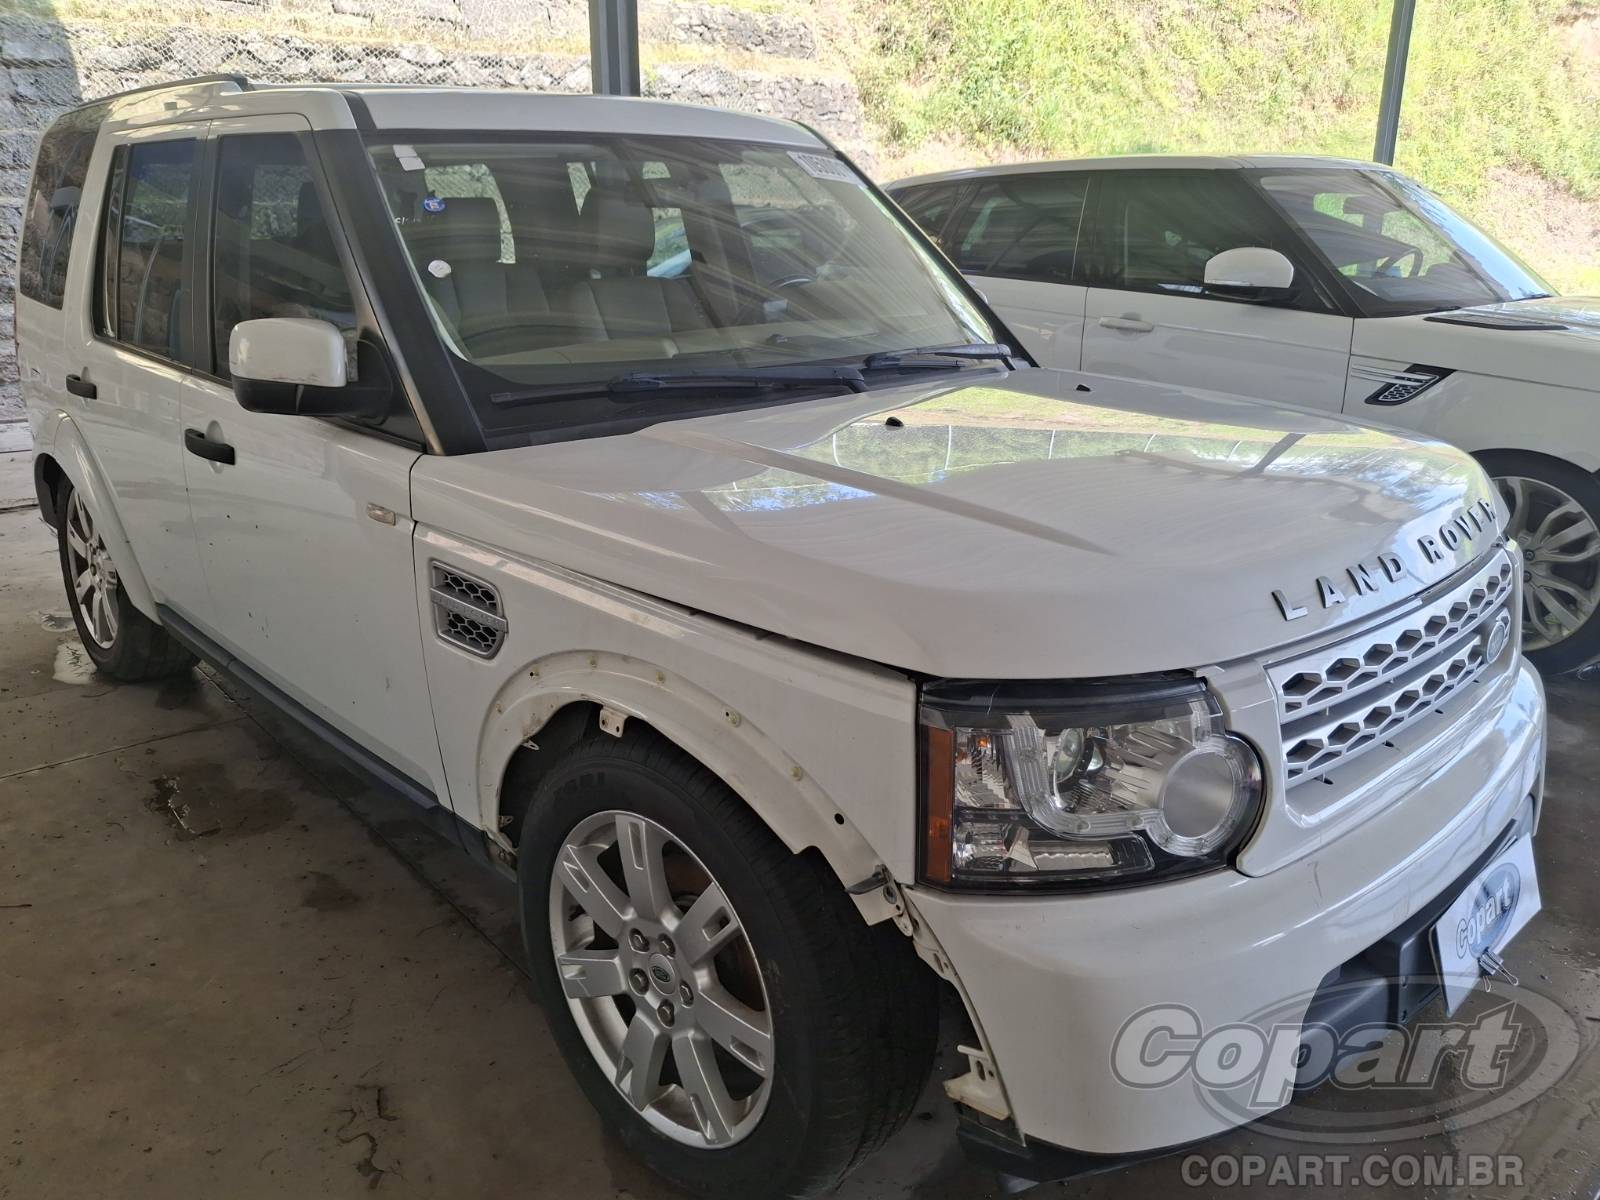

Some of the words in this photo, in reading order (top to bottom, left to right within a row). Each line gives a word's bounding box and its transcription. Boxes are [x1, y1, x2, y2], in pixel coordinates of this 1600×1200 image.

[1271, 552, 1407, 621] LAND
[1417, 498, 1496, 564] ROVER
[1456, 877, 1515, 959] Copart
